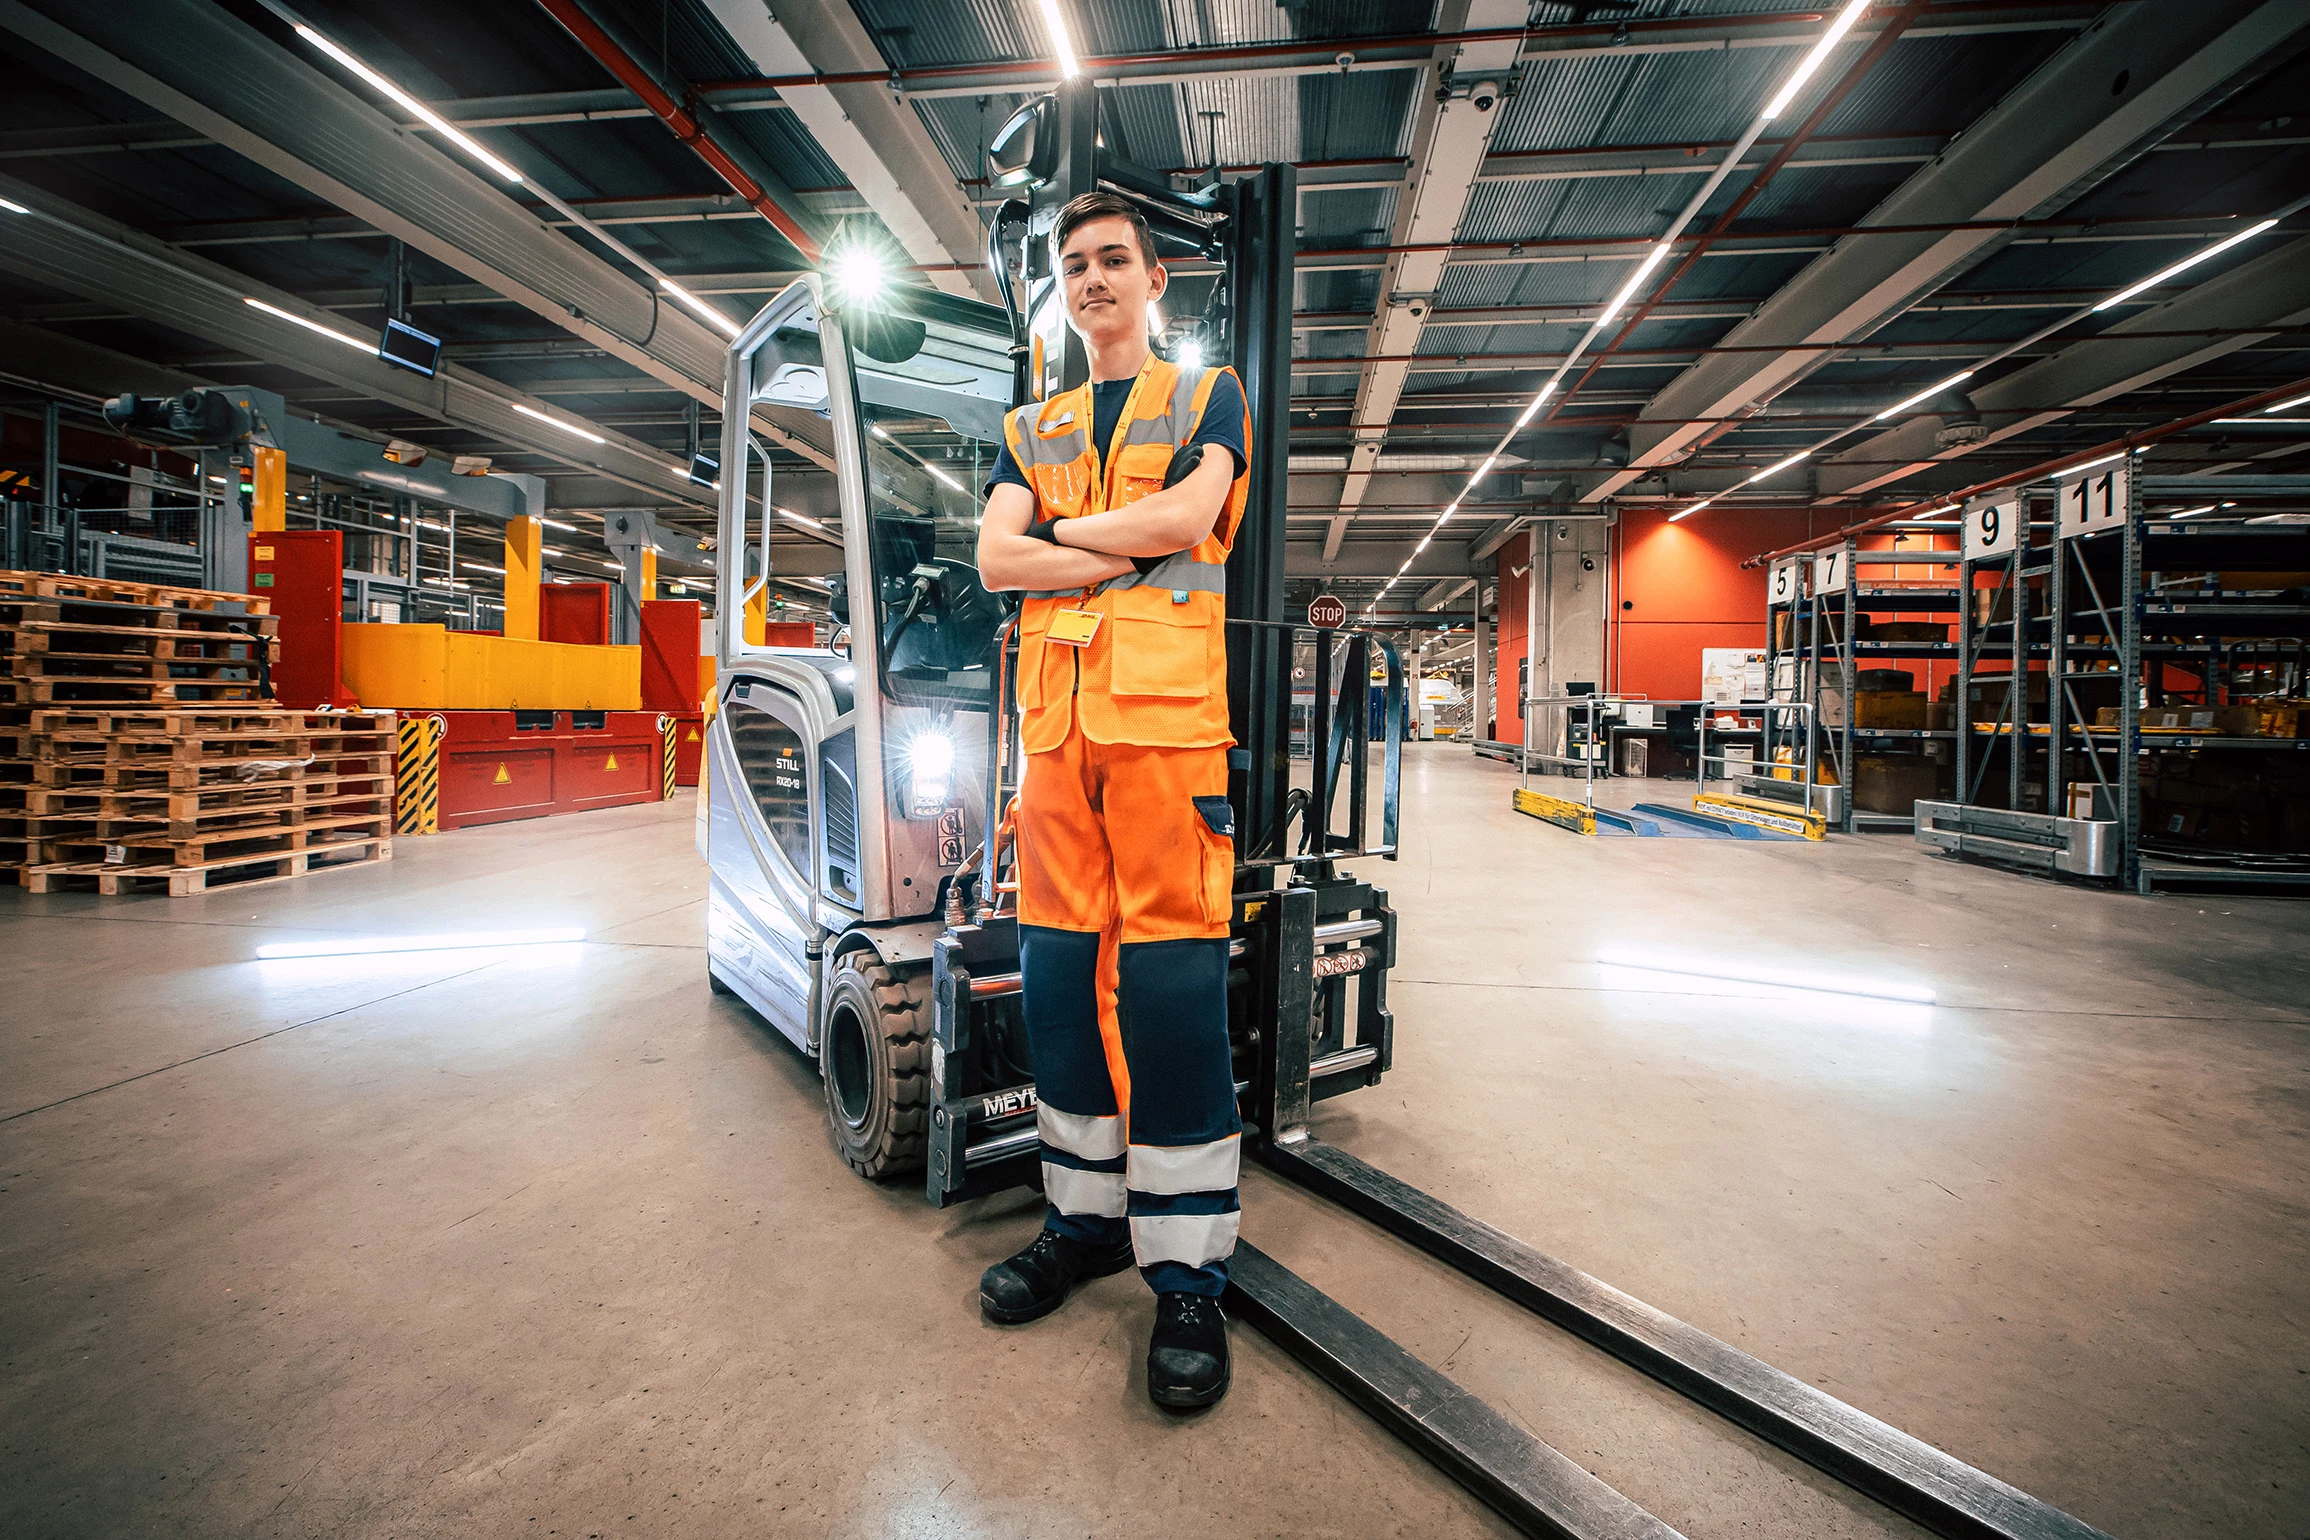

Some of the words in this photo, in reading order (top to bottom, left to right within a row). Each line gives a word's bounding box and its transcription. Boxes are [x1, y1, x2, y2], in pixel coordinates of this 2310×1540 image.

[2072, 470, 2113, 523] 11
[1981, 505, 1999, 546] 9
[1777, 567, 1786, 596] 5
[1826, 553, 1836, 584] 7
[1312, 607, 1342, 621] STOP
[776, 758, 799, 771] STILL
